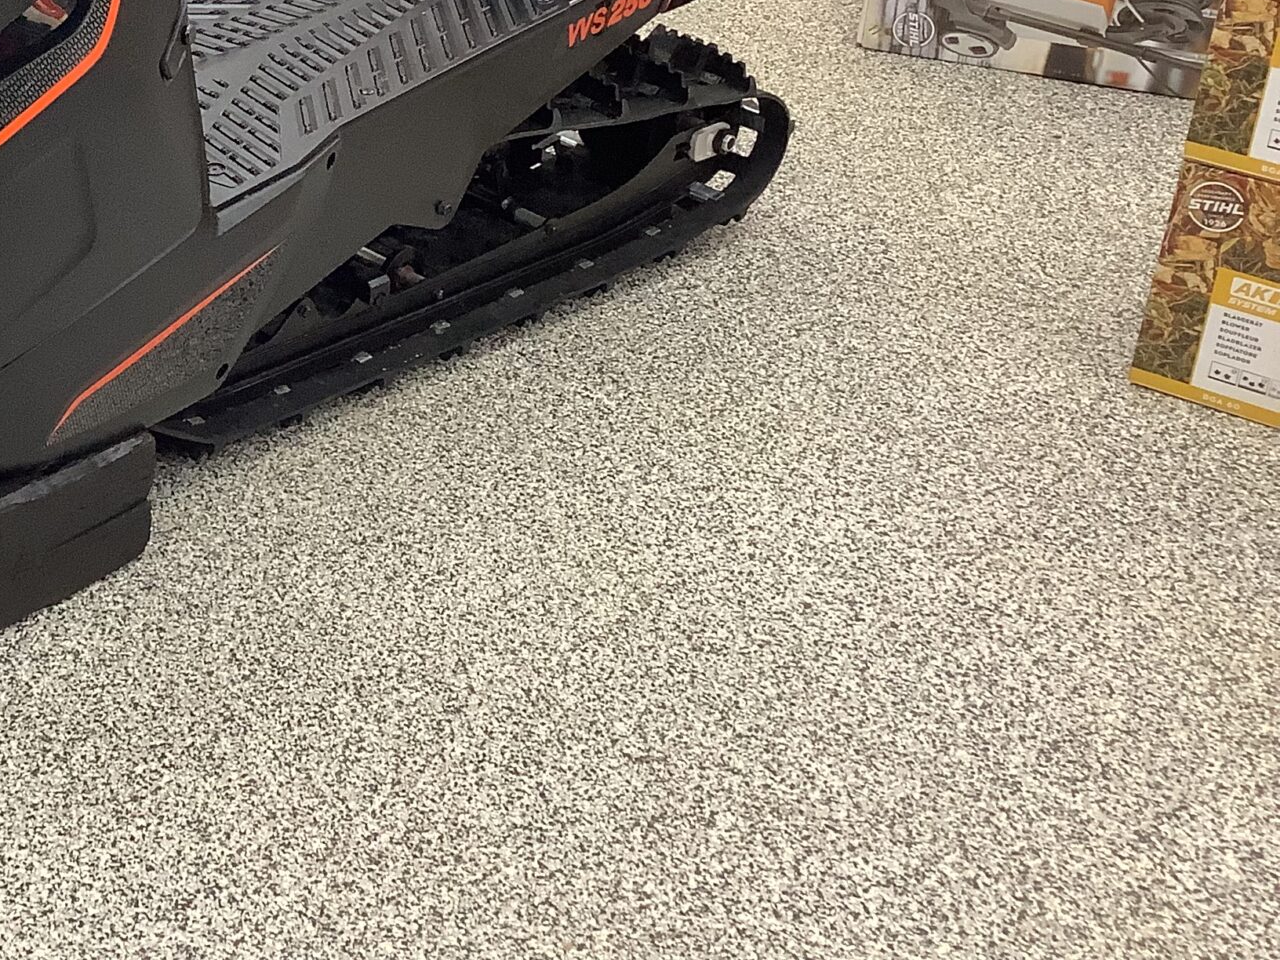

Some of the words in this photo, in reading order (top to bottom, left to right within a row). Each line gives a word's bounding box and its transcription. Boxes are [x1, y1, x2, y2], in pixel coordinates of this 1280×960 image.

[908, 12, 919, 47] STIHL
[1188, 198, 1245, 215] STIHL
[1203, 218, 1227, 227] 1926
[1227, 297, 1278, 316] SYSTEM
[1221, 320, 1250, 332] BLOWER
[1217, 334, 1263, 352] BLADBLAZER
[1219, 327, 1259, 343] SOUFFLEUR
[1214, 349, 1251, 365] SOPLADOR
[1202, 392, 1223, 406] BGA
